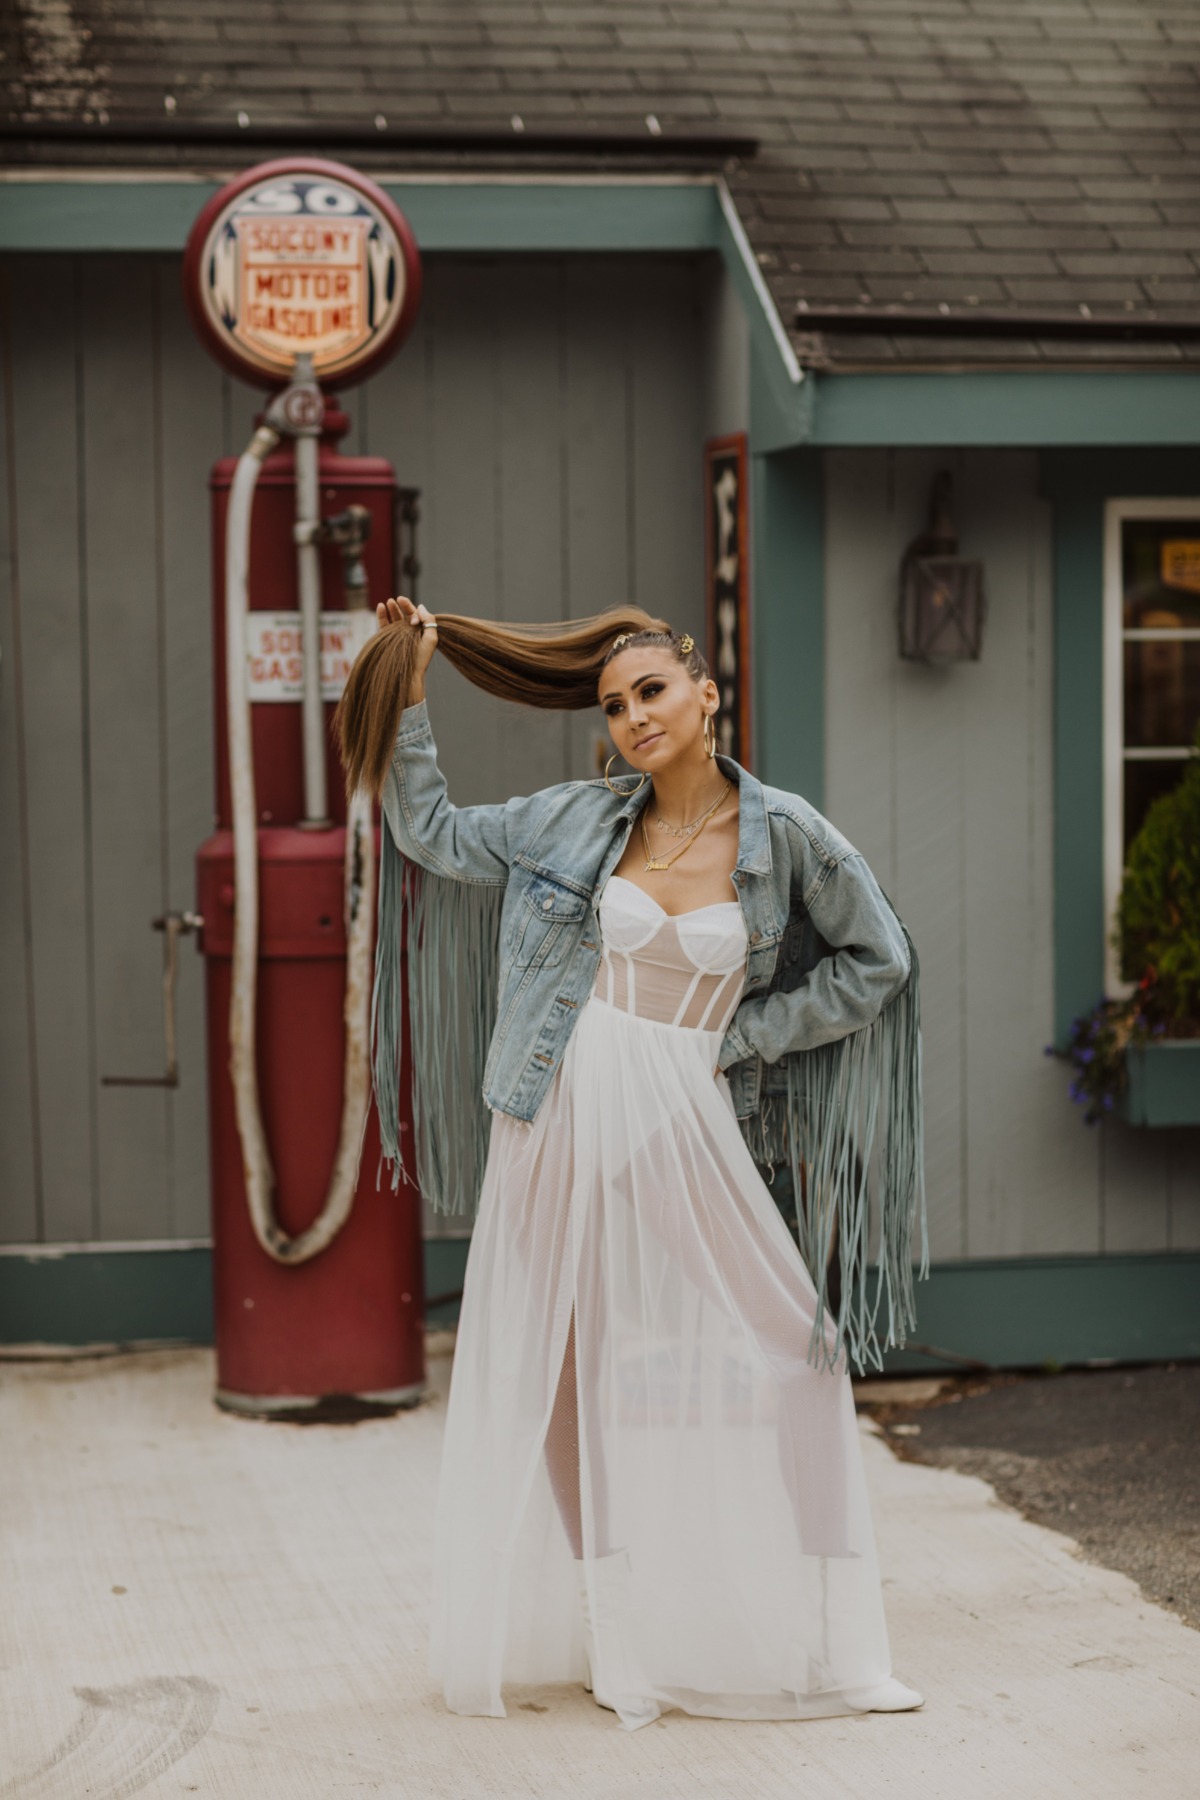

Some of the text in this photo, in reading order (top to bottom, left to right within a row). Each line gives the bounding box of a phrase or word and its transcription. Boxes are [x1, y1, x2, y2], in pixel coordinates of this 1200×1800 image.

[252, 227, 353, 252] SOCONY
[255, 273, 351, 299] MOTOR
[251, 303, 355, 338] GASOLINE
[250, 657, 352, 683] GASLIN
